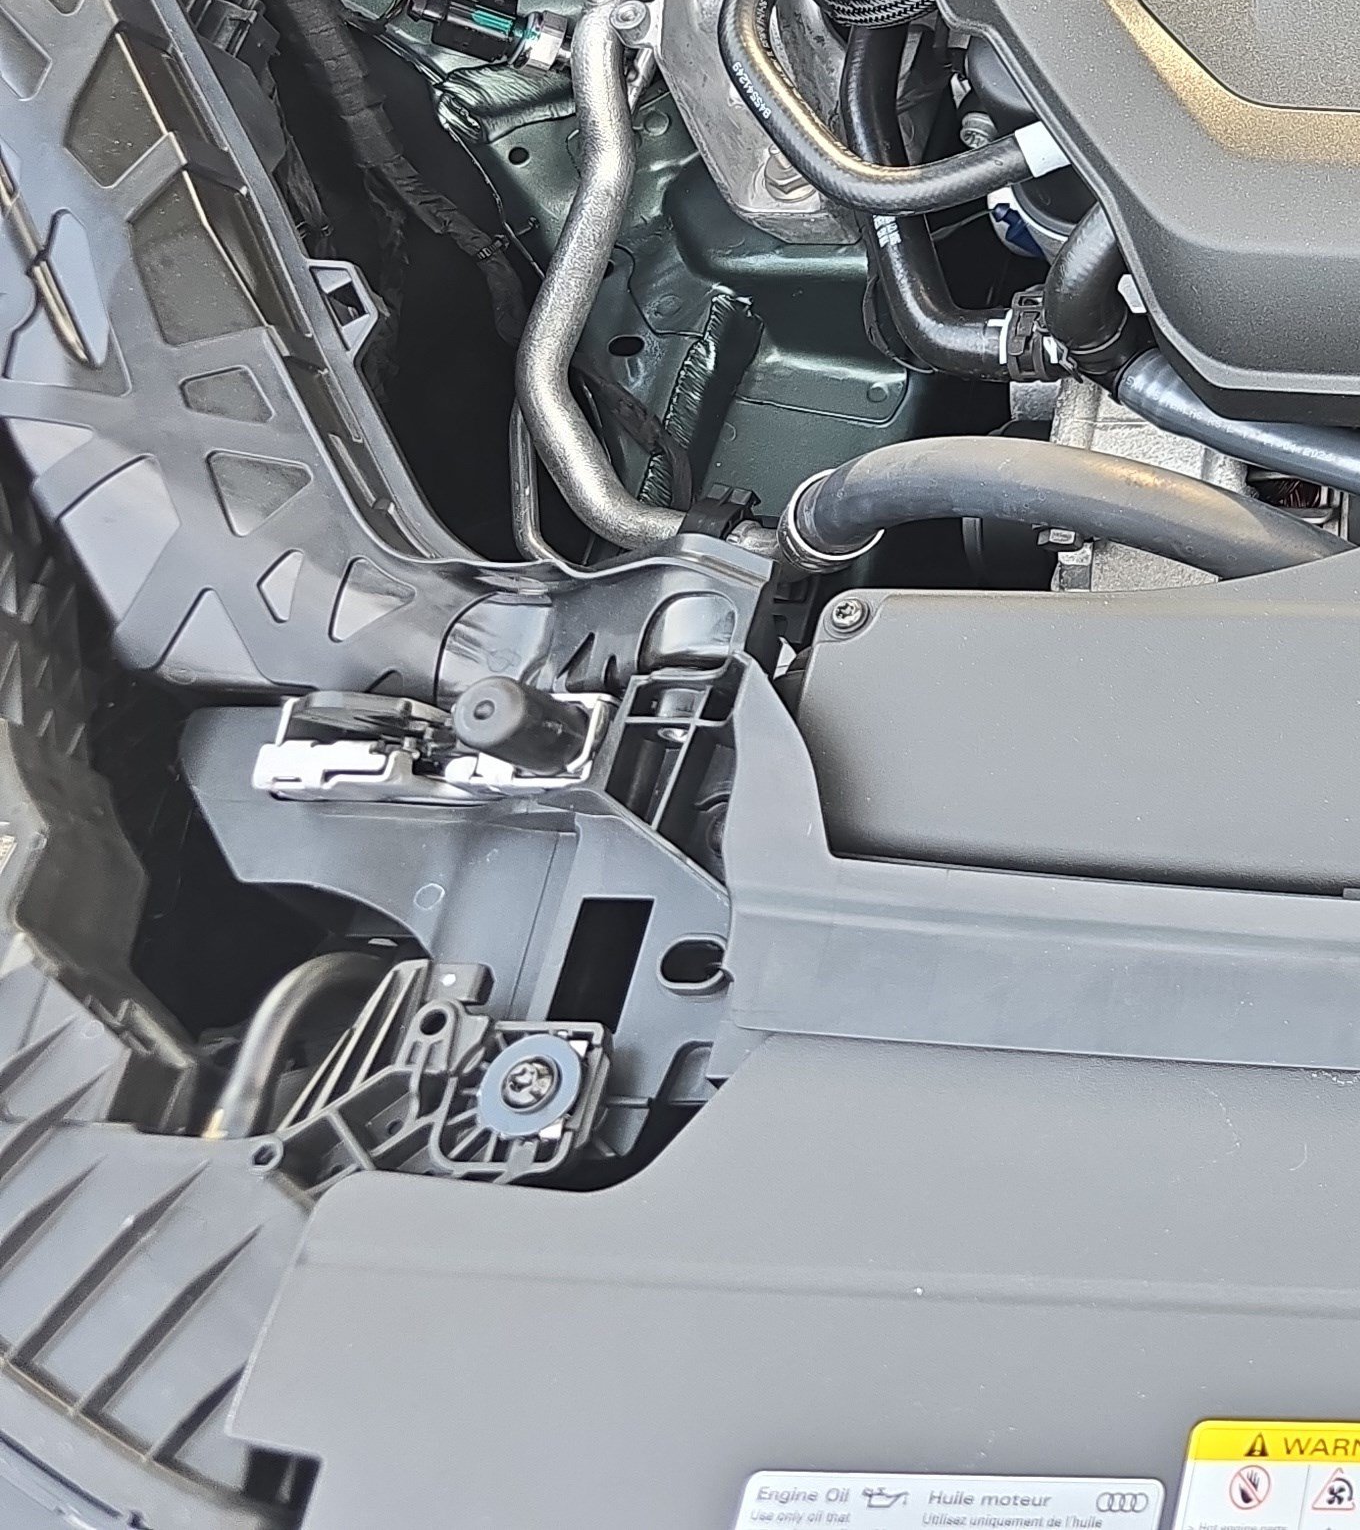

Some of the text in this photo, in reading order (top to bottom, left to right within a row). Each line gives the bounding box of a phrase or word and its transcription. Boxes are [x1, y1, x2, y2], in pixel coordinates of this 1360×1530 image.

[756, 1485, 851, 1504] Engine Oil
[928, 1490, 1053, 1508] Huile moteur
[750, 1510, 851, 1525] Use only oil that
[921, 1512, 1103, 1530] Utilisez uniquement de l'huile
